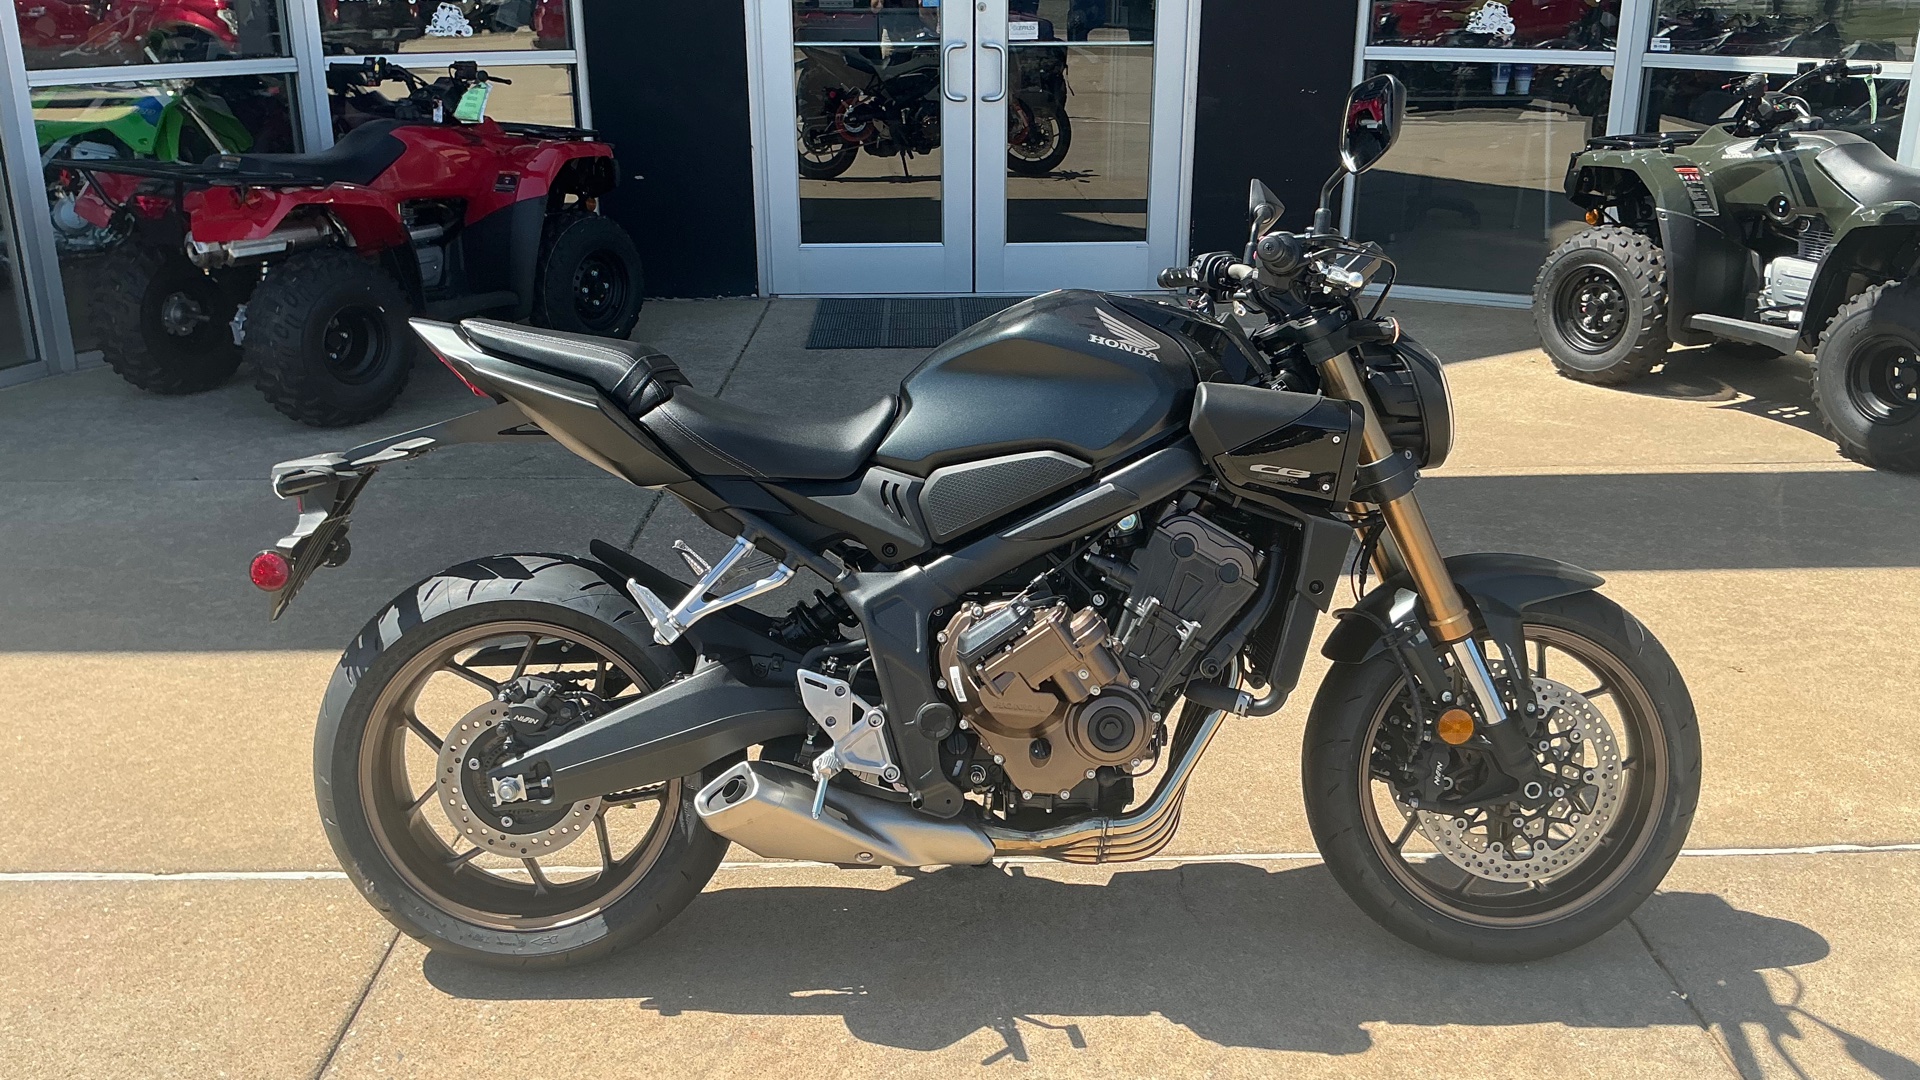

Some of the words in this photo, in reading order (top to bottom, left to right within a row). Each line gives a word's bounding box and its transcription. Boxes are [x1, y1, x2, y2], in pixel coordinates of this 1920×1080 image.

[1088, 334, 1160, 363] HONDA
[1249, 464, 1311, 479] CB
[993, 702, 1045, 714] HONDA
